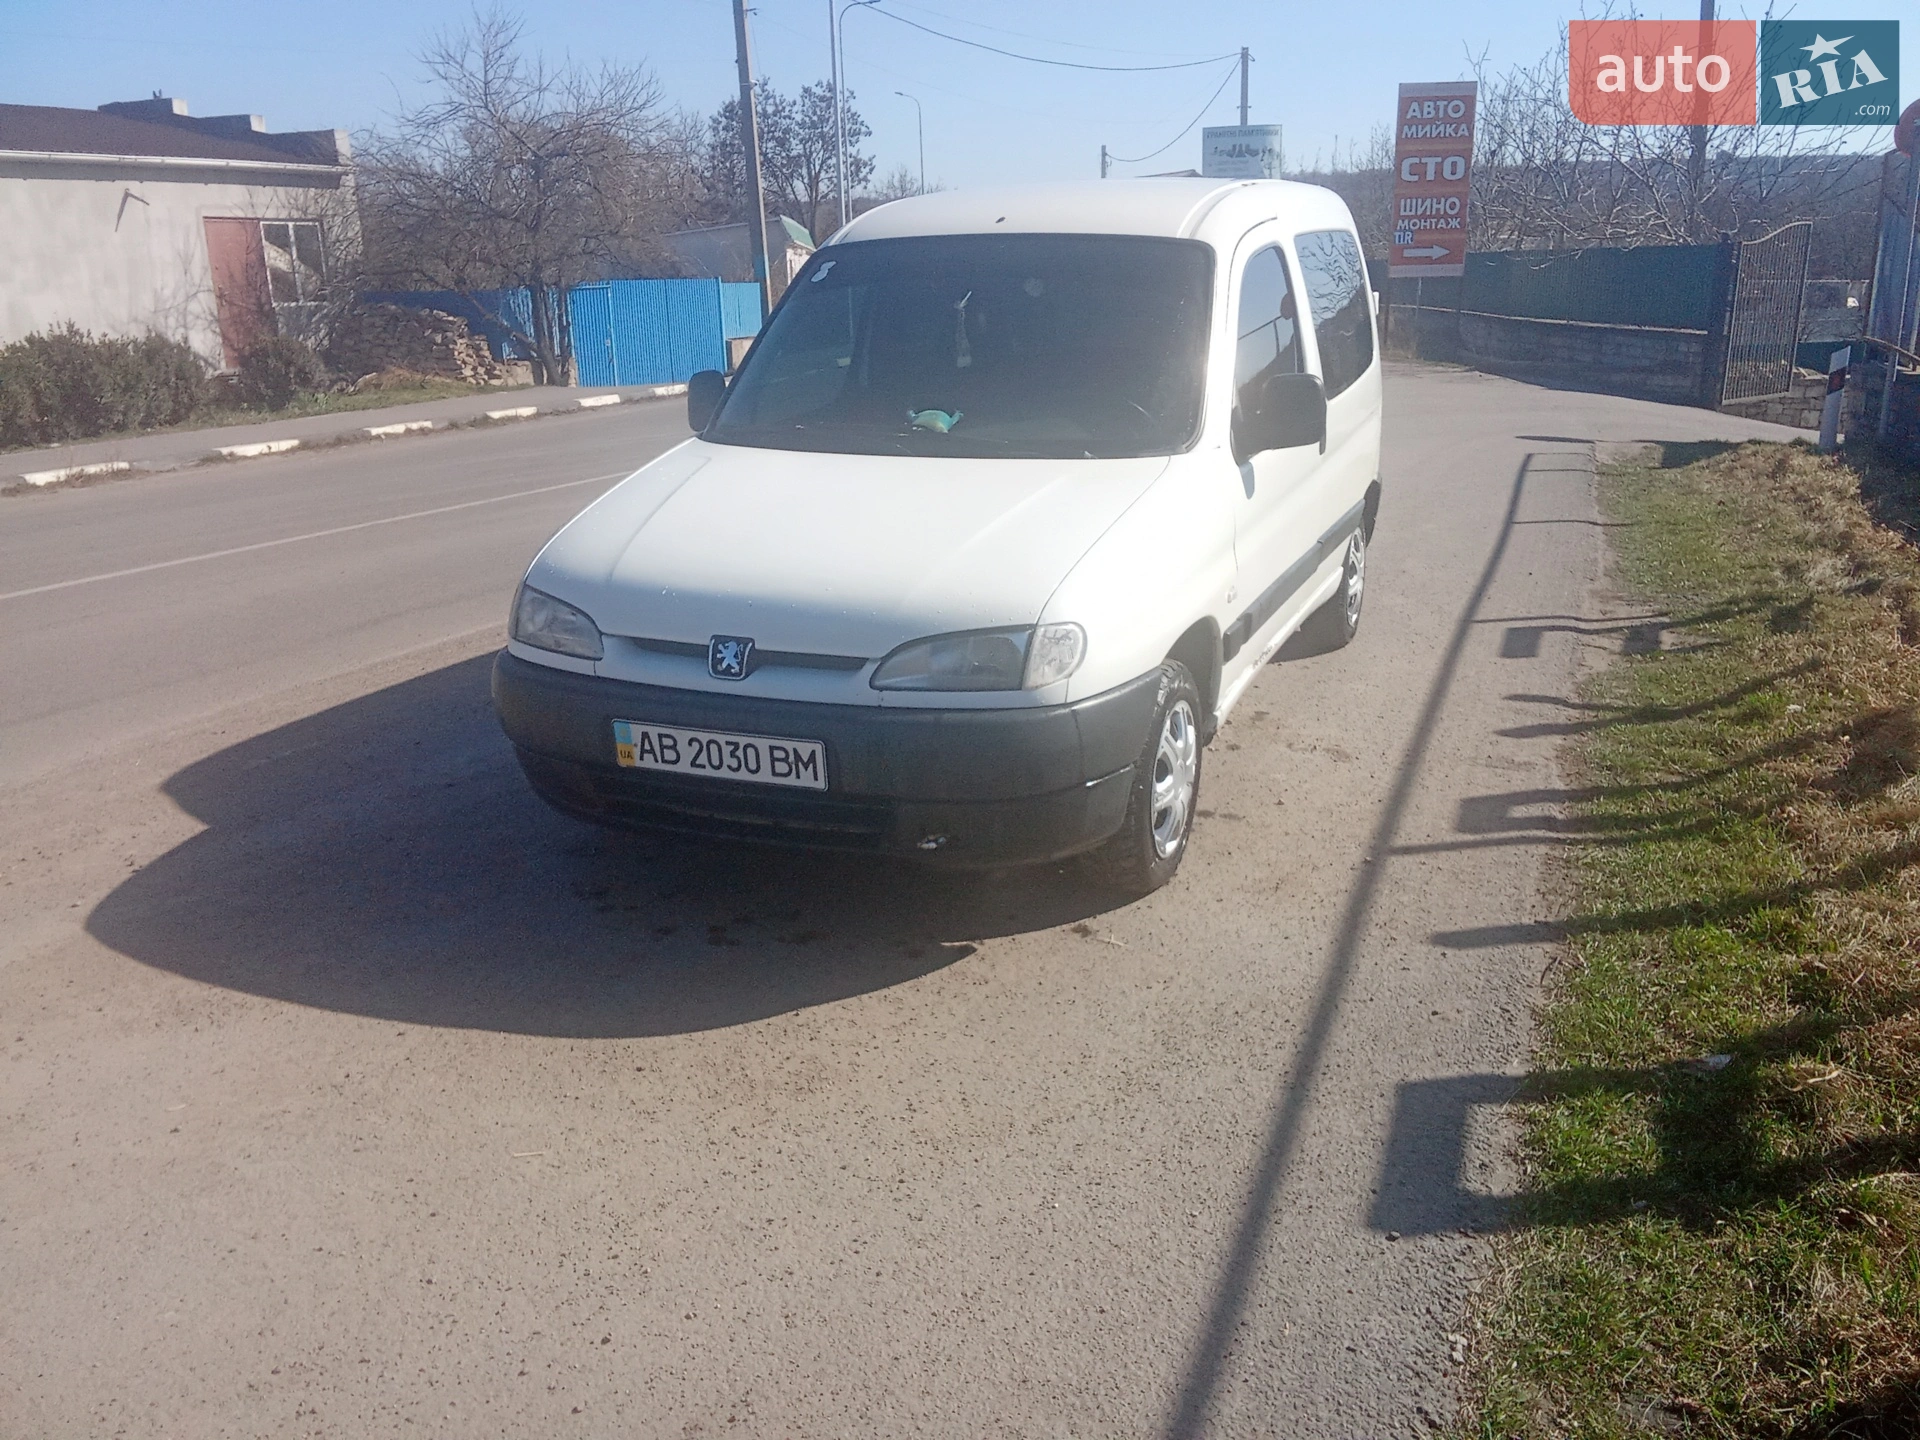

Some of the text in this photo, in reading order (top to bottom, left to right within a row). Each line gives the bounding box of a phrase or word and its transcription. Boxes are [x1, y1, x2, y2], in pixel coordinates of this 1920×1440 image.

[1406, 99, 1466, 119] АВТО
[1401, 120, 1470, 139] МИЙКА
[1400, 156, 1466, 182] СТО
[1400, 196, 1461, 216] ШИНО
[1397, 217, 1461, 230] МОНТАЖ
[1394, 231, 1414, 245] TIR
[619, 749, 634, 760] UA
[639, 731, 819, 782] AB 2030 BM
